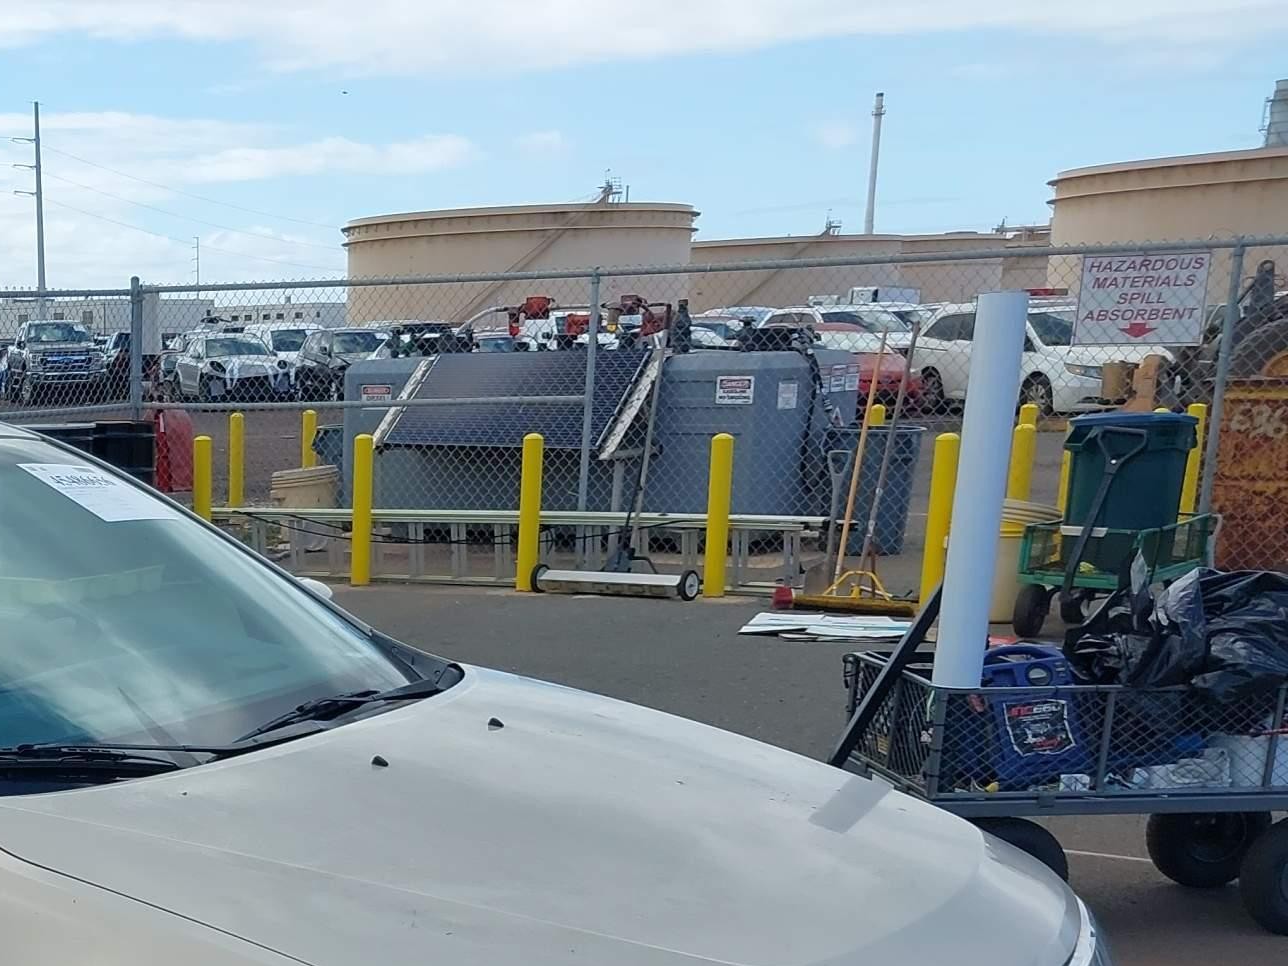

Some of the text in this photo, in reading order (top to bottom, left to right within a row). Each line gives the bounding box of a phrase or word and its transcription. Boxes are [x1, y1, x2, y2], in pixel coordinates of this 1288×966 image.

[1089, 257, 1204, 273] HAZARDOUS
[1092, 274, 1197, 289] MATERIALS
[1117, 292, 1167, 305] SPILL
[1082, 308, 1199, 323] ABSORBENT
